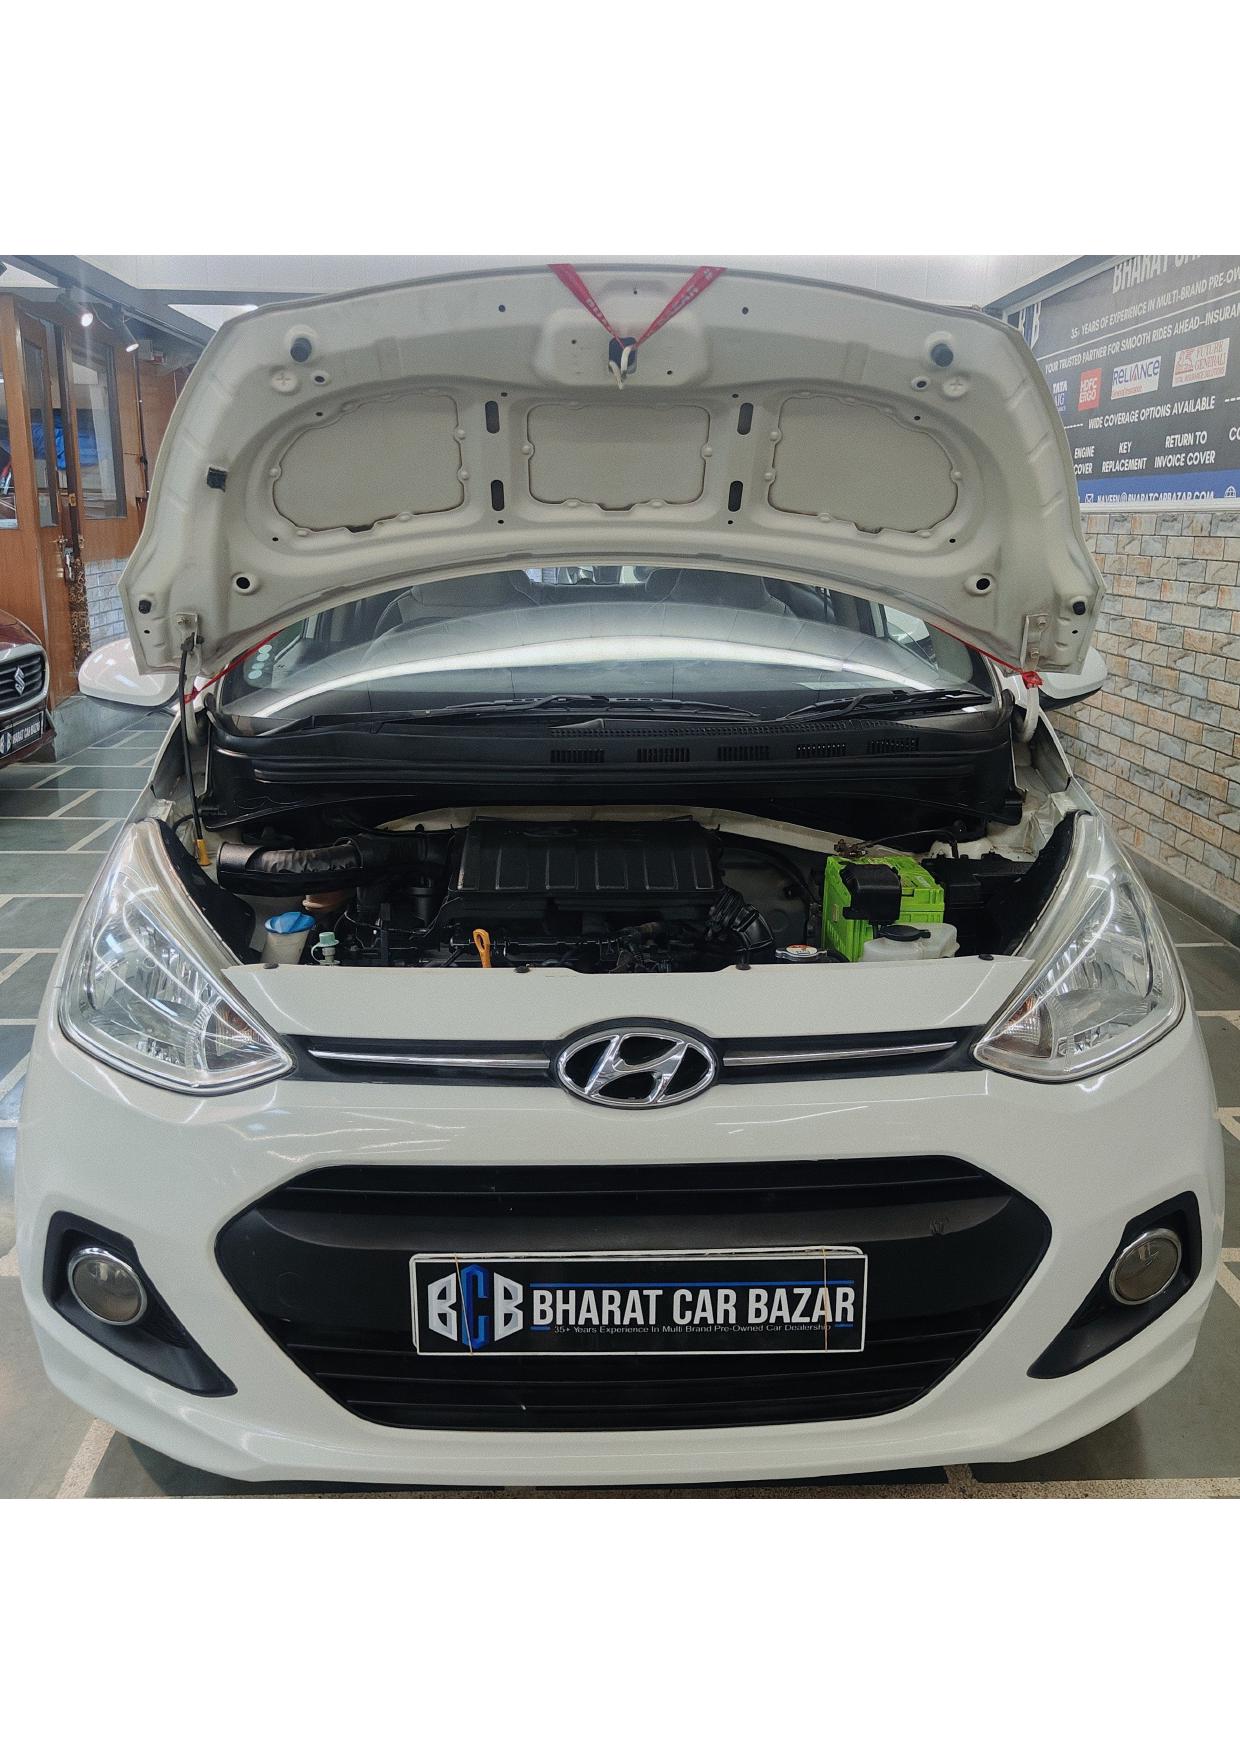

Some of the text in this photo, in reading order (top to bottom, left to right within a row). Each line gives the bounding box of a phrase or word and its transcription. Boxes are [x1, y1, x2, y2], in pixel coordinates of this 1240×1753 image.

[1081, 319, 1100, 336] YEARS
[1100, 315, 1109, 329] OF
[1109, 301, 1147, 326] EXPERIENCE
[1148, 298, 1156, 312] IN
[1156, 280, 1207, 309] MULTI-BRAND
[1045, 360, 1059, 375] YOUR
[1059, 354, 1081, 370] TRUSTED
[1082, 344, 1107, 363] PARTNER
[1107, 341, 1120, 355] FOR
[1120, 331, 1151, 351] SMOOTH
[1151, 324, 1172, 342] RIDES
[1053, 380, 1067, 394] TATA
[1088, 396, 1215, 429] WIDE COVERAGE OPTIONS AVAILABLE
[1119, 441, 1132, 454] KEY
[1165, 430, 1207, 448] RETURN TO
[1074, 446, 1095, 459] ENGINE
[1154, 450, 1216, 468] INVOICE COVER
[1073, 462, 1093, 475] COVER
[1102, 457, 1147, 472] REPLACEMENT
[427, 1264, 524, 1349] BCB
[533, 1287, 855, 1326] BHARAT CAR BAZAR
[600, 1326, 649, 1335] Experience
[651, 1325, 660, 1333] In
[662, 1325, 683, 1333] Multi
[714, 1324, 763, 1332] Pre-Owned
